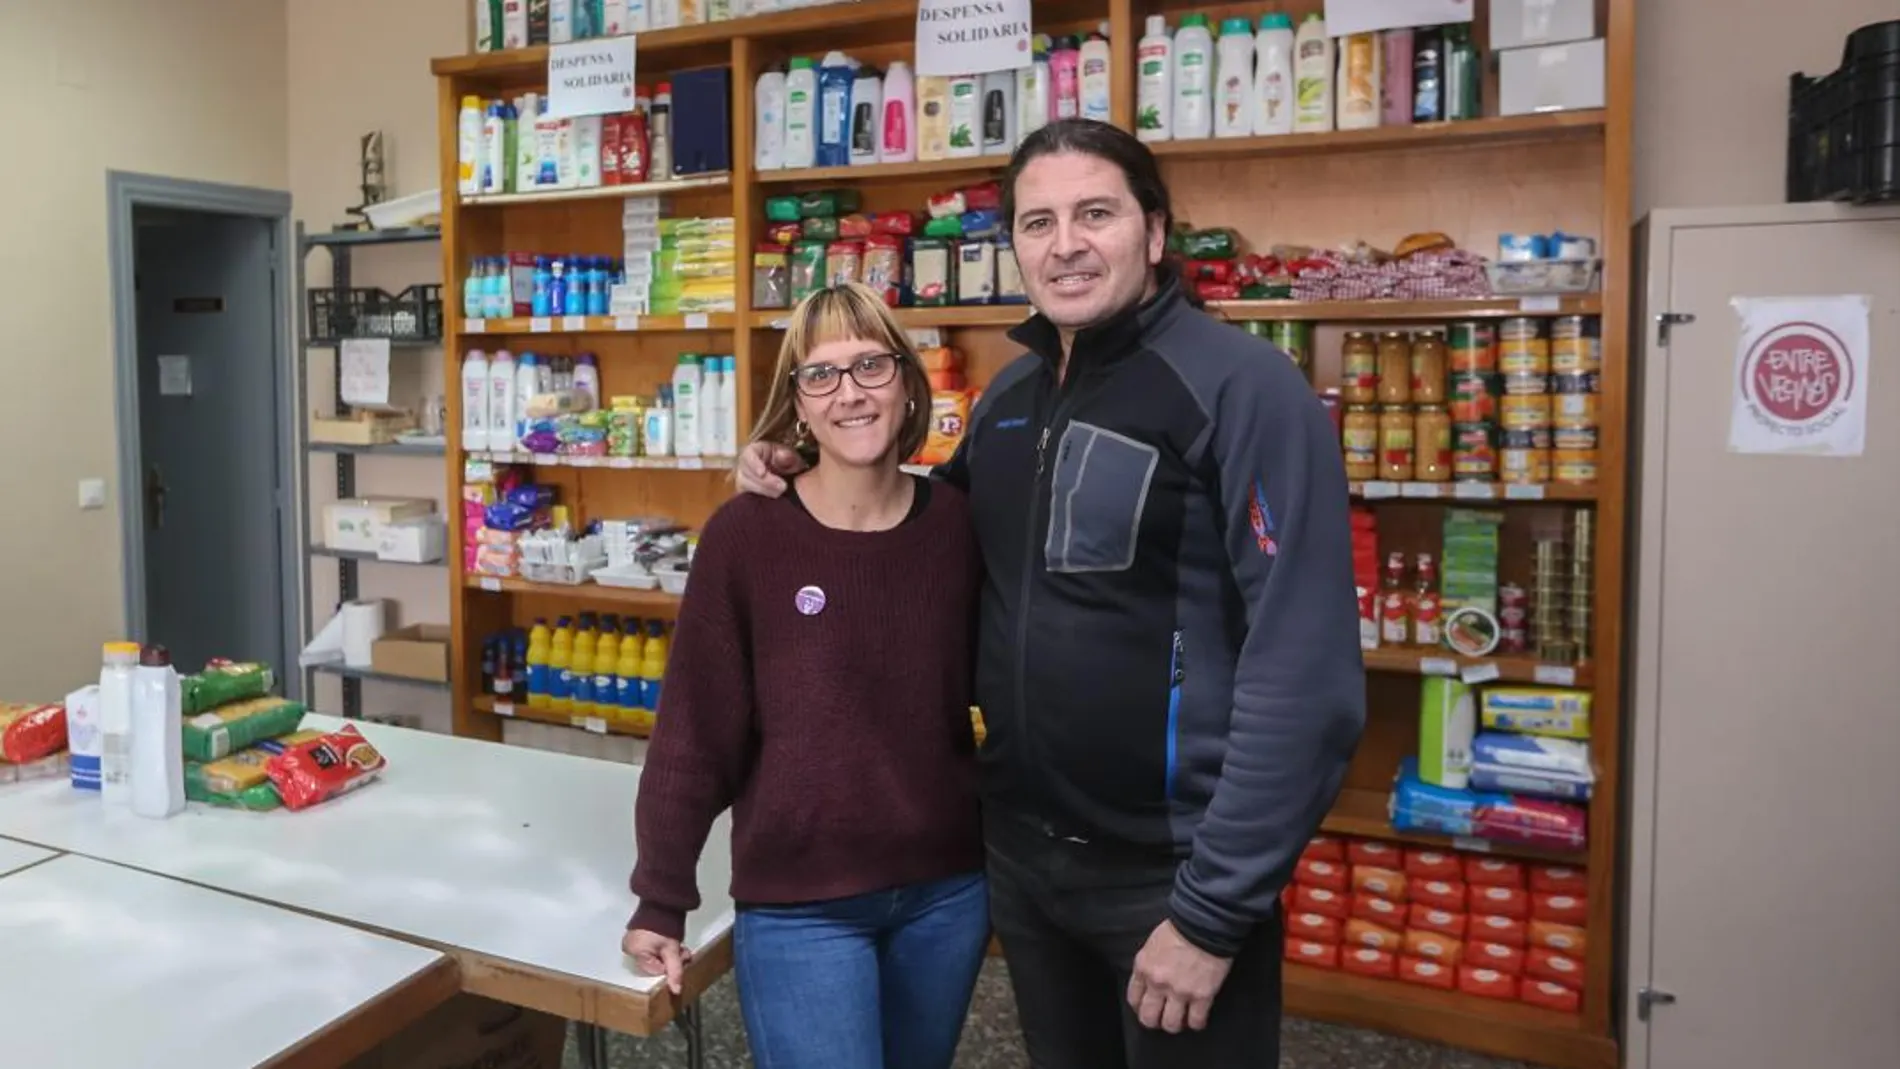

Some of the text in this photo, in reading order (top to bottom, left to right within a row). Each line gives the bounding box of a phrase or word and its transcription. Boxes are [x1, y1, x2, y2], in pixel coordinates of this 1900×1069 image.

[920, 2, 1004, 22] DESPENSA
[937, 21, 1029, 44] SOLIDARIA
[550, 51, 614, 71] DESPENSA
[563, 70, 632, 88] SOLIDARIA
[1764, 349, 1834, 375] ENTRE
